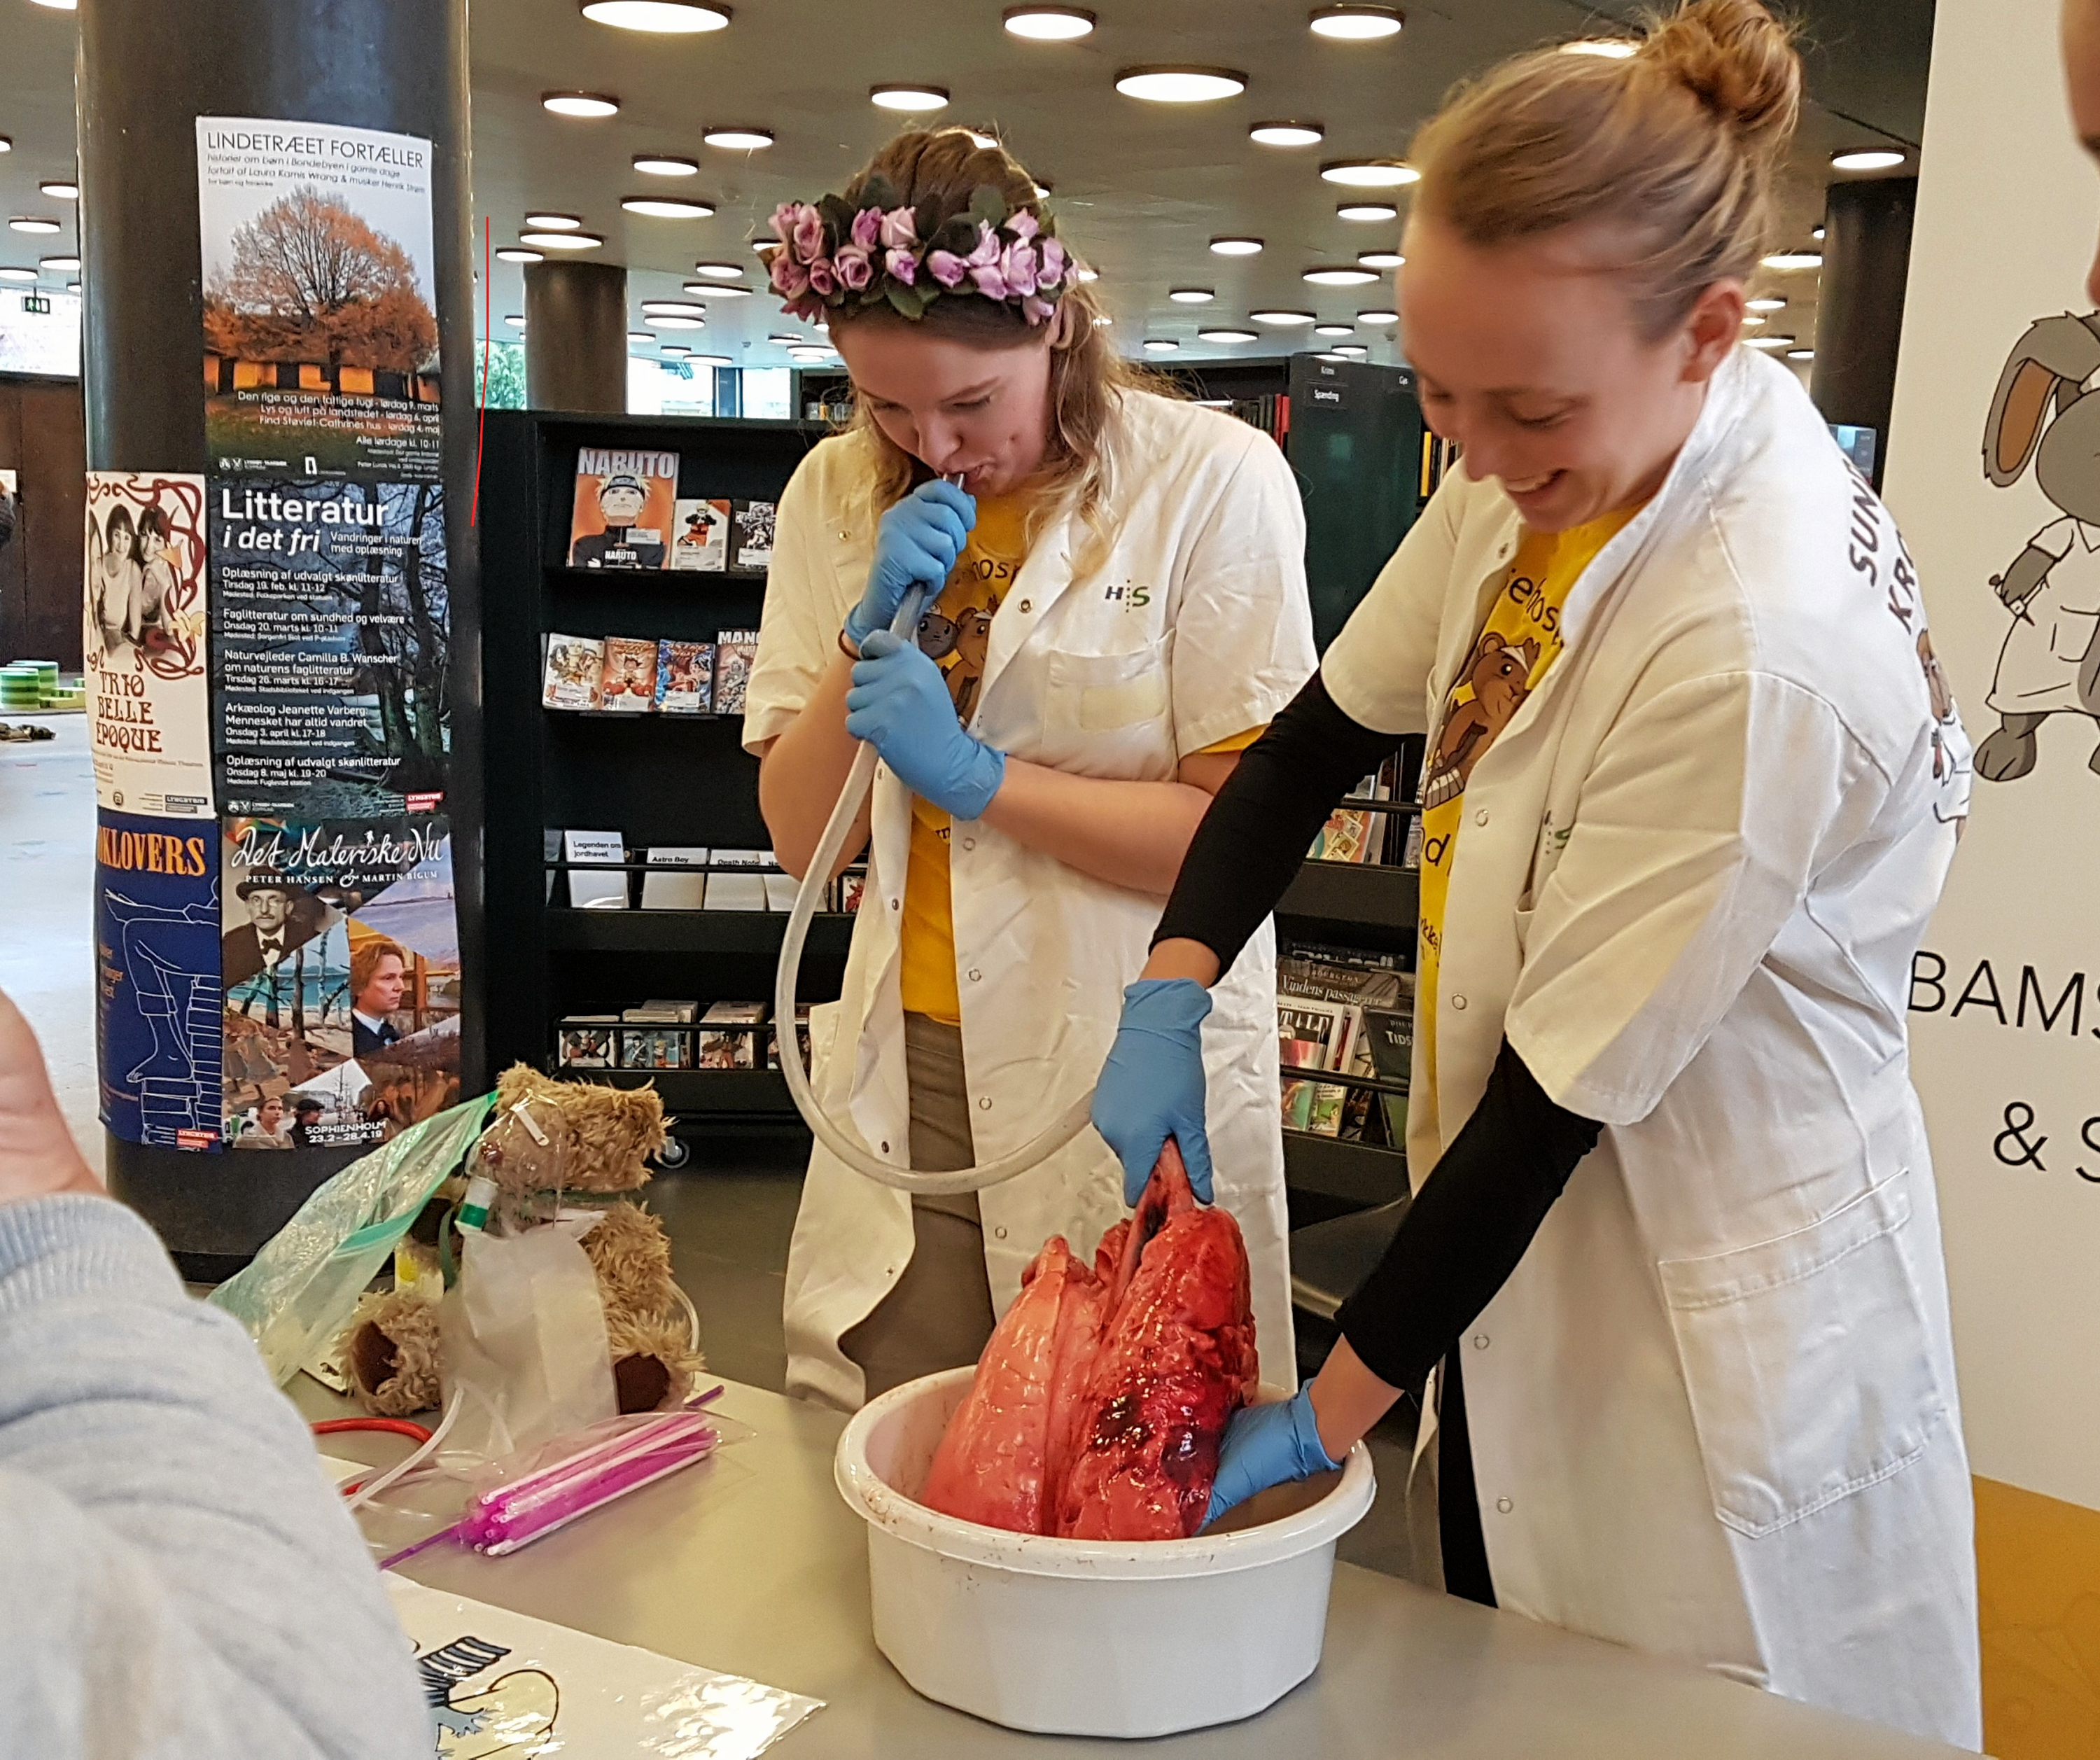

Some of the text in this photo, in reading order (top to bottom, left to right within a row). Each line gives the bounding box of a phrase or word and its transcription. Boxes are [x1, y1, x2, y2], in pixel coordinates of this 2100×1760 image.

[207, 132, 424, 169] LINDETRÆET FORTÆLLER
[207, 153, 241, 162] historier
[262, 156, 284, 165] børn
[291, 158, 344, 170] Bondebyen
[351, 164, 377, 174] gamle
[379, 167, 400, 178] dage
[208, 166, 234, 175] fortalt
[237, 167, 246, 176] af
[249, 167, 276, 176] Laura
[309, 172, 338, 183] Wrang
[340, 174, 347, 183] &
[350, 176, 379, 187] musiker
[238, 391, 439, 412] Den rige og den fattige fugl lørdag 9. marts
[261, 403, 440, 424] Lys og luft på landstedet lørdag 6. april
[259, 415, 280, 425] Find
[367, 420, 381, 430] hus
[388, 423, 416, 433] lørdag
[426, 424, 440, 435] maj
[356, 435, 373, 445] Alle
[375, 436, 407, 449] lørdage
[420, 439, 440, 449] 10-11
[578, 449, 675, 479] NARUTO
[223, 489, 389, 526] Litteratur
[223, 525, 321, 556] i det fri
[330, 531, 421, 545] Vandringer naturen
[330, 543, 405, 557] med oplæsning.
[605, 549, 637, 561] NARUTO
[222, 566, 399, 584] Oplæsning af udvalgt skønlitteratur
[223, 579, 255, 592] Tirsdag
[271, 582, 286, 592] feb.
[288, 582, 300, 592] kl.
[301, 584, 325, 593] 11-12
[224, 608, 405, 625] Faglitteratur om sundhed og velvære
[224, 621, 339, 634] Onsdag 20. marts kl. 10-11
[224, 650, 398, 664] Naturvejleder Camilla B. Wanscher
[225, 664, 354, 676] om naturens faglitteratur
[99, 671, 145, 698] TRIO
[225, 674, 339, 686] Tirsdag 26. marts kl. 16-17
[322, 687, 354, 696] indgangen
[98, 697, 154, 725] BELLE
[225, 701, 276, 715] Arkæolog
[278, 703, 325, 715] Jeanette
[225, 715, 368, 728] Mennesket har altid vandret
[225, 727, 326, 739] Onsdag 3. april kl. 17-18
[323, 740, 355, 748] indgangen
[226, 755, 400, 769] Oplæsning af udvalgt skønlitteratur
[227, 767, 259, 778] Onsdag
[260, 769, 269, 777] 8.
[270, 769, 287, 778] maj
[288, 769, 300, 778] kl.
[231, 821, 444, 868] Det Maleriske Nu
[573, 841, 609, 850] Legenden
[246, 875, 281, 884] PETER
[286, 875, 334, 884] HANSEN
[339, 868, 360, 888] &
[362, 873, 403, 883] MARTIN
[1282, 975, 1324, 997] Vindens
[305, 1120, 388, 1136] SOPHIENHOLM
[1993, 1101, 2049, 1172] &
